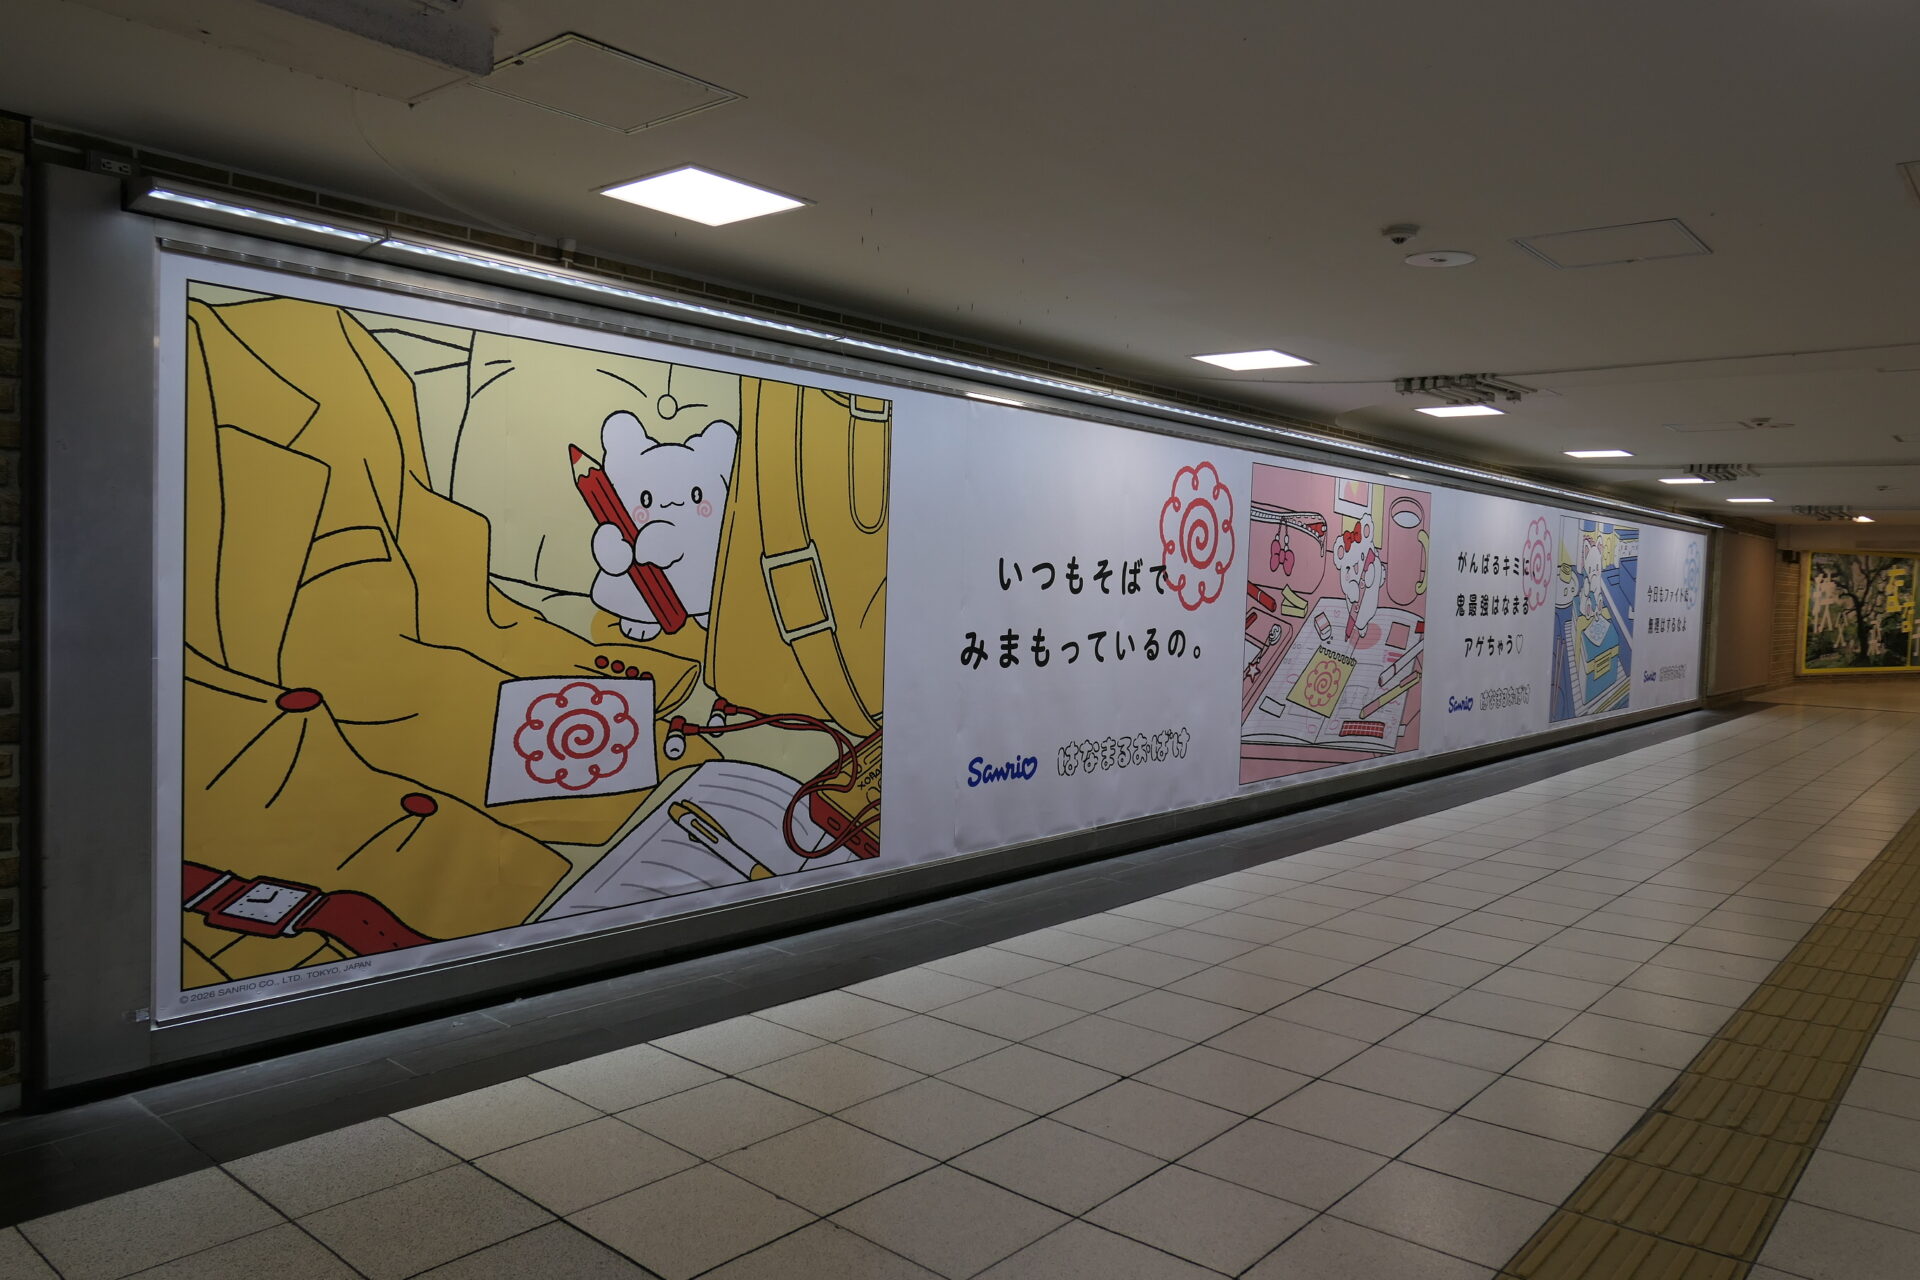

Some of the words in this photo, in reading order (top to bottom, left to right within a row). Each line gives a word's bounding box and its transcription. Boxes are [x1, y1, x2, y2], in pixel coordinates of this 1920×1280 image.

[998, 555, 1169, 596] いつもそばで
[1455, 593, 1529, 617] 鬼最強はなまる
[960, 627, 1202, 670] みまもっているの。
[1056, 726, 1191, 777] はなまるおばけ
[218, 982, 257, 997] SANRIO
[343, 960, 372, 972] JAPAN
